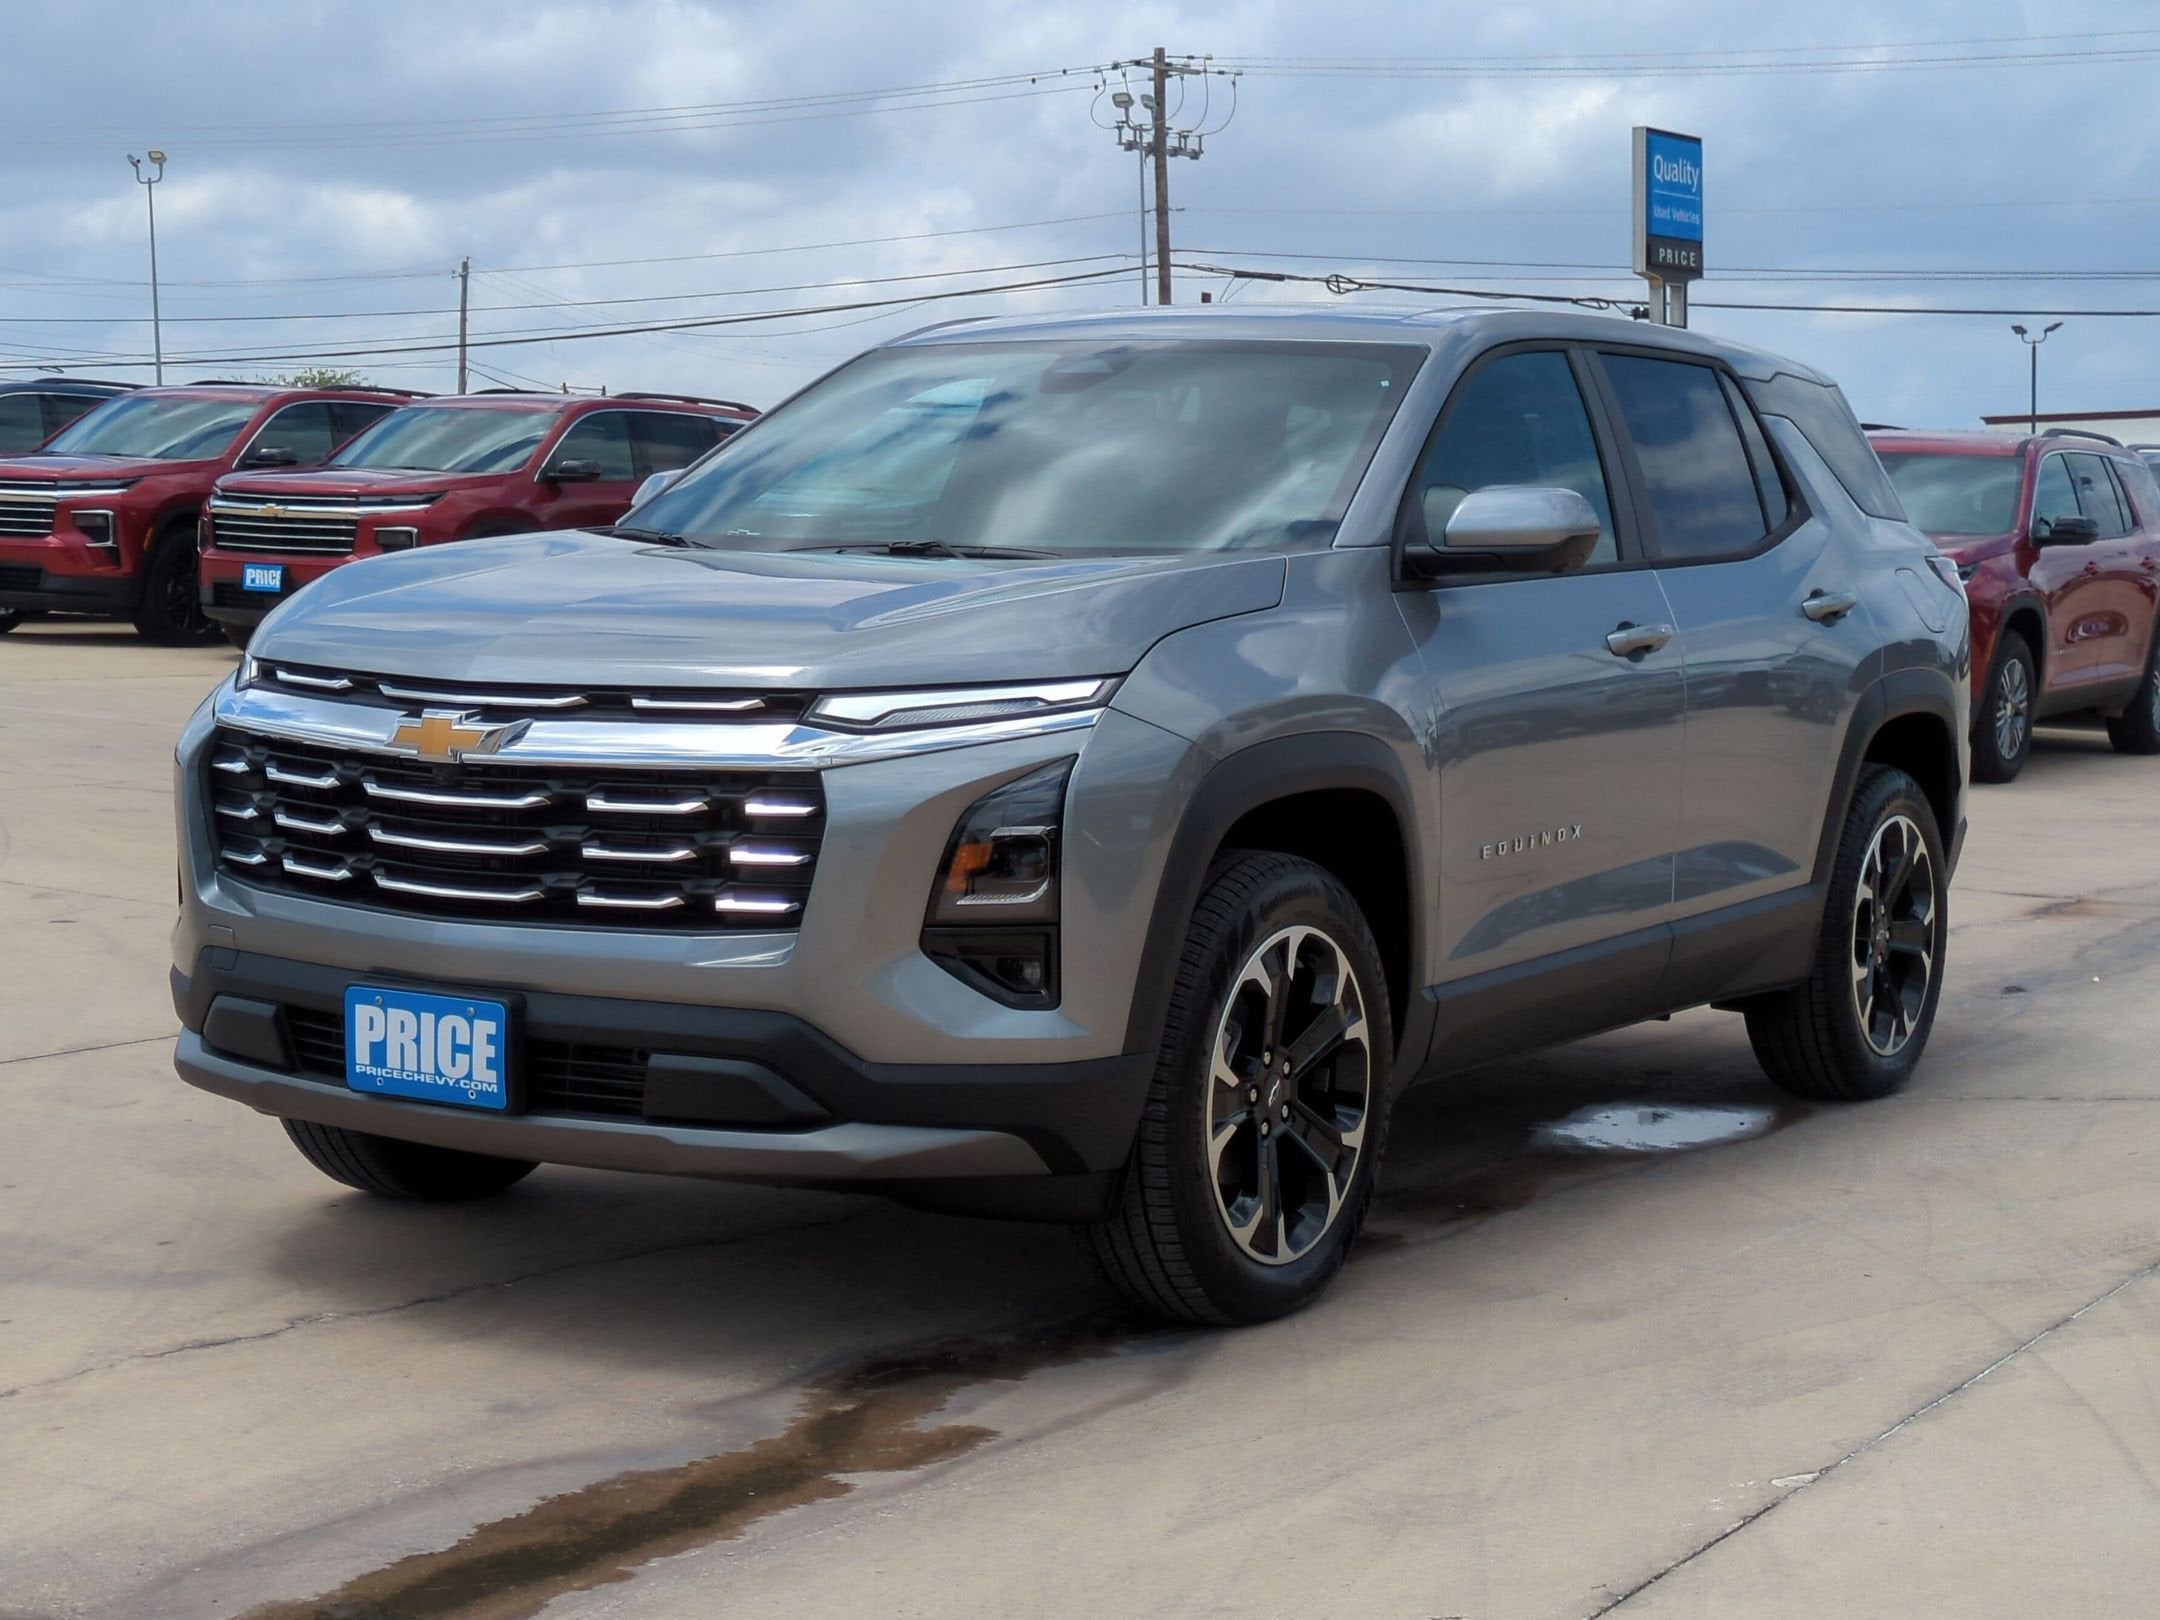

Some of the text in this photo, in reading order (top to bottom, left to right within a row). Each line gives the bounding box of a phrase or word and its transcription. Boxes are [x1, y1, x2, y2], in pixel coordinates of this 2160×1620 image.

[1653, 154, 1699, 192] Quality
[1653, 205, 1699, 224] Used Vehicles
[1659, 248, 1696, 267] PRICE
[1482, 825, 1581, 860] EQUINOX
[355, 1004, 497, 1084] PRICE
[355, 1065, 498, 1093] PRICECHEVY.COM
